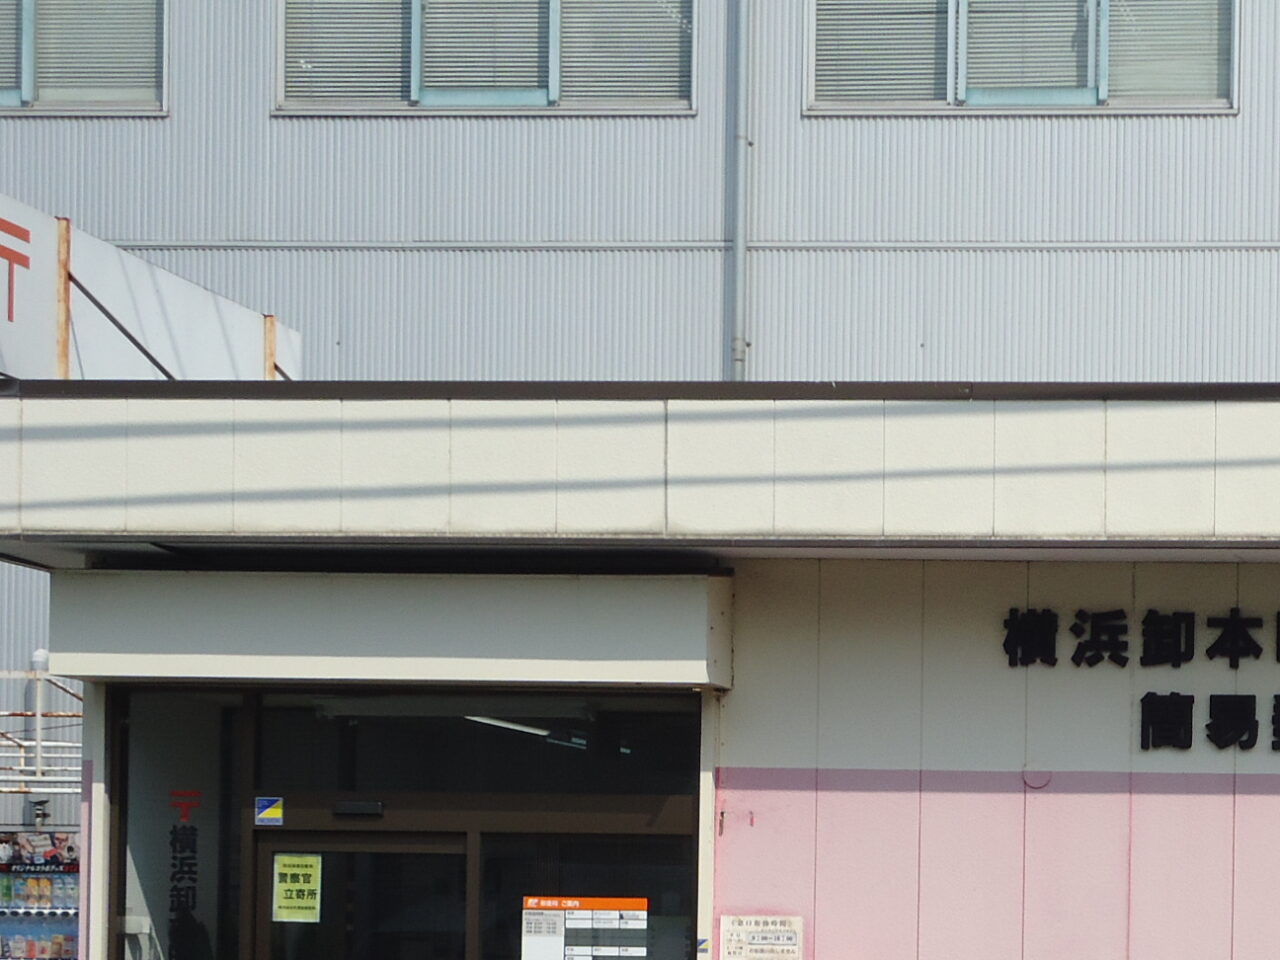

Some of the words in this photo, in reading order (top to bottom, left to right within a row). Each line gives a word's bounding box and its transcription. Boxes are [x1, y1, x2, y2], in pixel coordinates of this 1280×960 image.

[278, 872, 312, 884] 警察官
[283, 888, 317, 900] 立寄所
